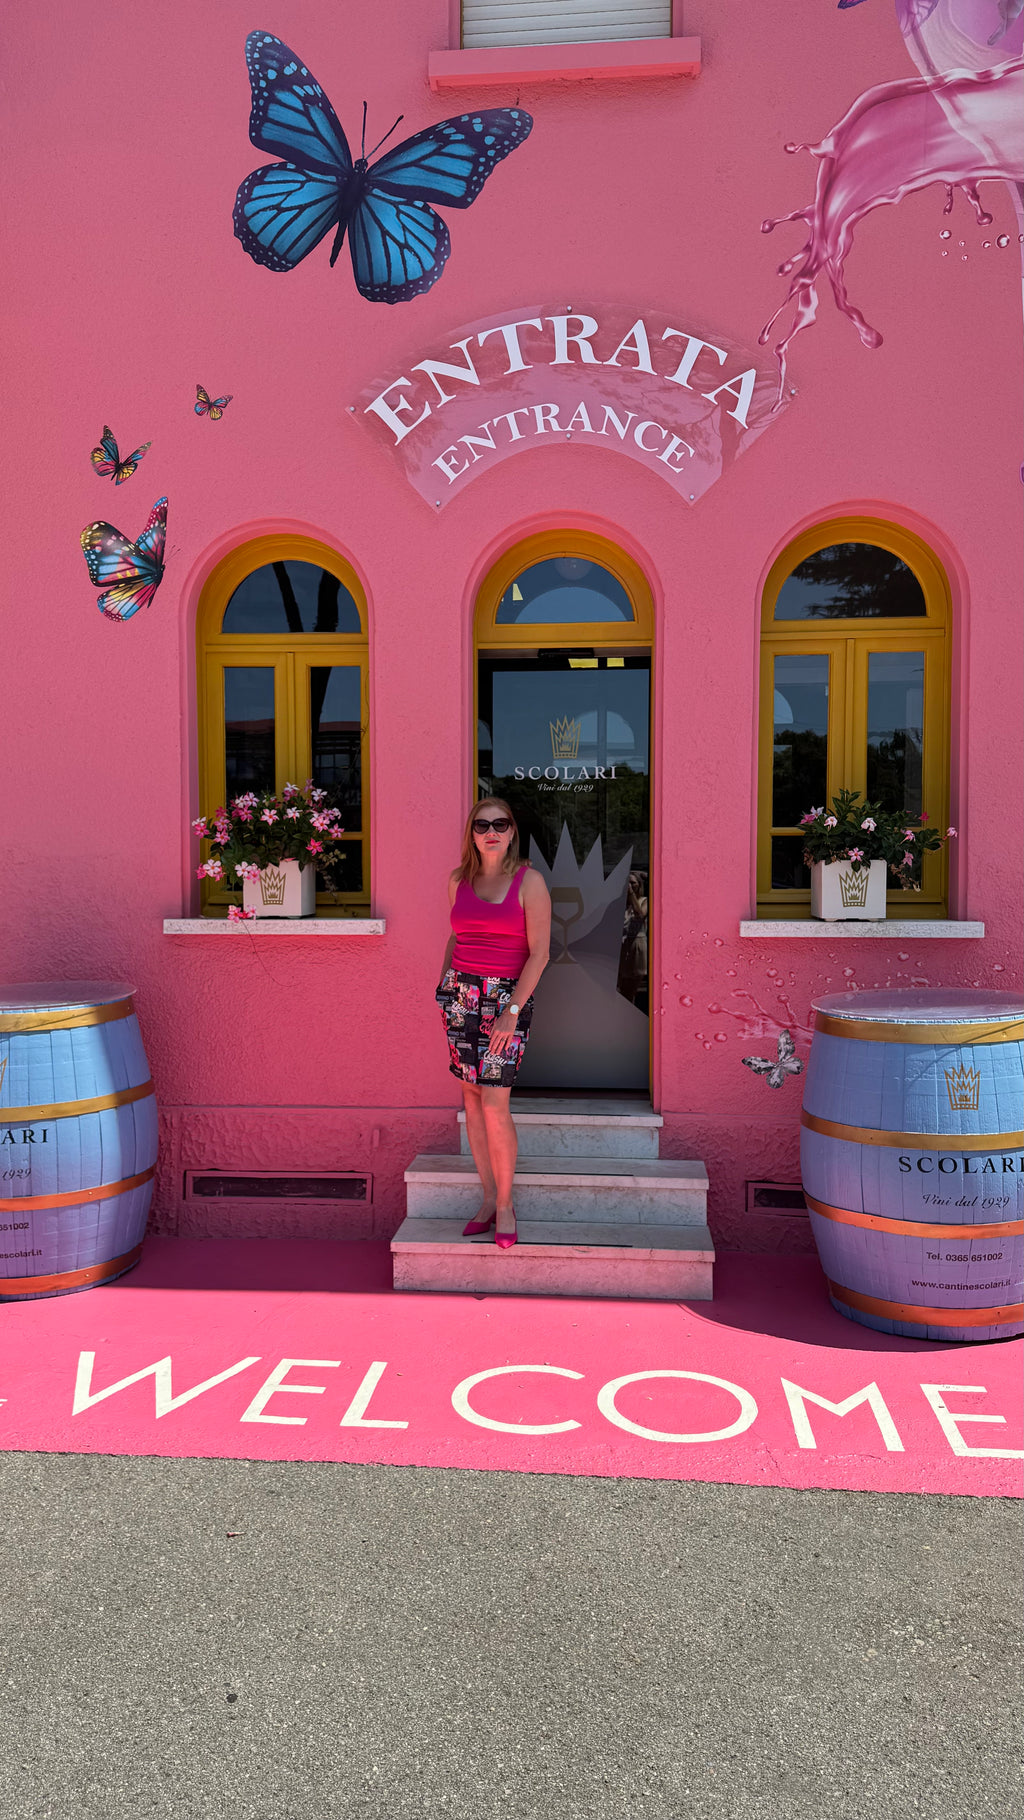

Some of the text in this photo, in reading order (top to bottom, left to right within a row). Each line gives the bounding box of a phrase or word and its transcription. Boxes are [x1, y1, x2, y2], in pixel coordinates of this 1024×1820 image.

[363, 314, 757, 446] ENTRATA
[431, 401, 695, 485] ENTRANCE
[514, 766, 617, 780] SCOLARI
[537, 783, 595, 793] Vini dal 1929
[922, 1193, 1011, 1210] Vini dal 1929
[926, 1251, 1003, 1262] Tel. 0365 651002
[911, 1279, 1012, 1291] www.cantinescolari.it
[71, 1350, 1024, 1460] WELCOME
